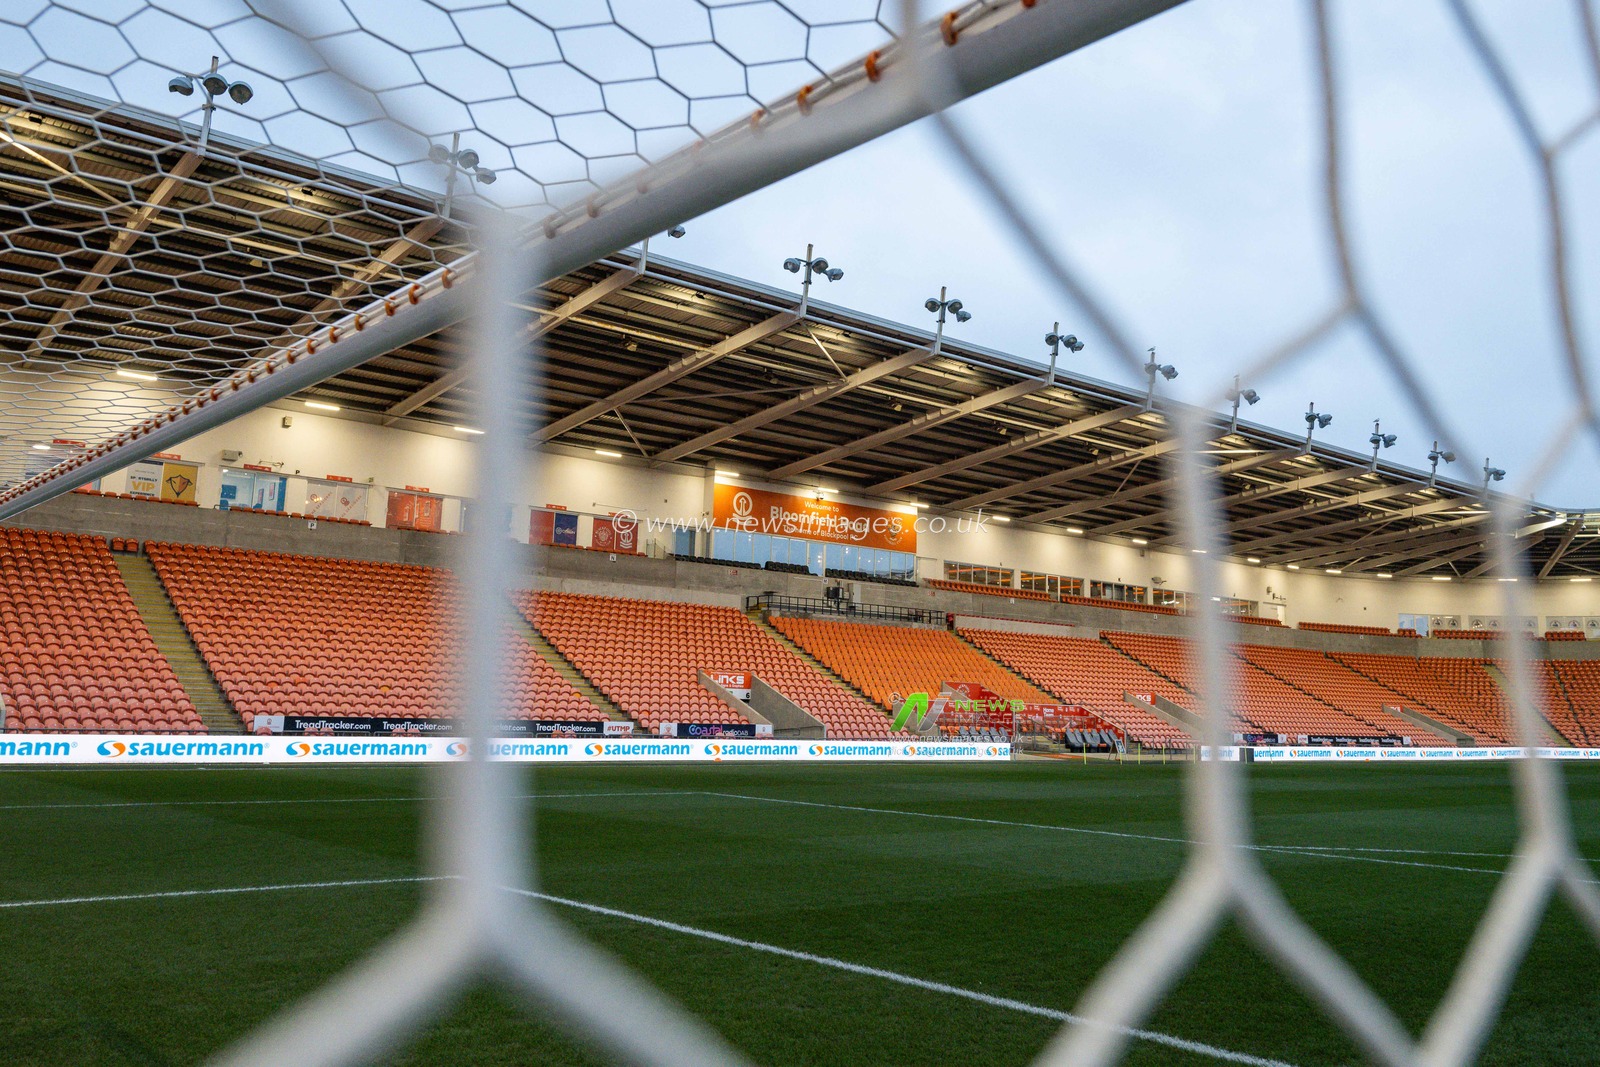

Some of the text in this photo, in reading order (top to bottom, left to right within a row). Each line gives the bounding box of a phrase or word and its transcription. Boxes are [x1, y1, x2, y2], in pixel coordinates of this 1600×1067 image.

[131, 481, 155, 492] VIP
[804, 501, 832, 511] Welcome
[770, 505, 837, 528] Bloomfield
[840, 516, 870, 533] Road
[820, 530, 849, 541] Blackpool
[295, 719, 371, 730] TreadTracker.com
[383, 721, 452, 731] TreadTracker.com
[536, 723, 596, 732] TreadTracker.com
[688, 724, 723, 735] Coastal
[128, 742, 264, 756] sauermann
[312, 743, 428, 756] sauermann
[604, 743, 690, 756] sauermann
[721, 744, 798, 756] sauermann
[824, 745, 891, 756] sauermann
[916, 745, 976, 756] sauermann
[1297, 749, 1331, 758] sauermann
[1343, 750, 1376, 758] sauermann
